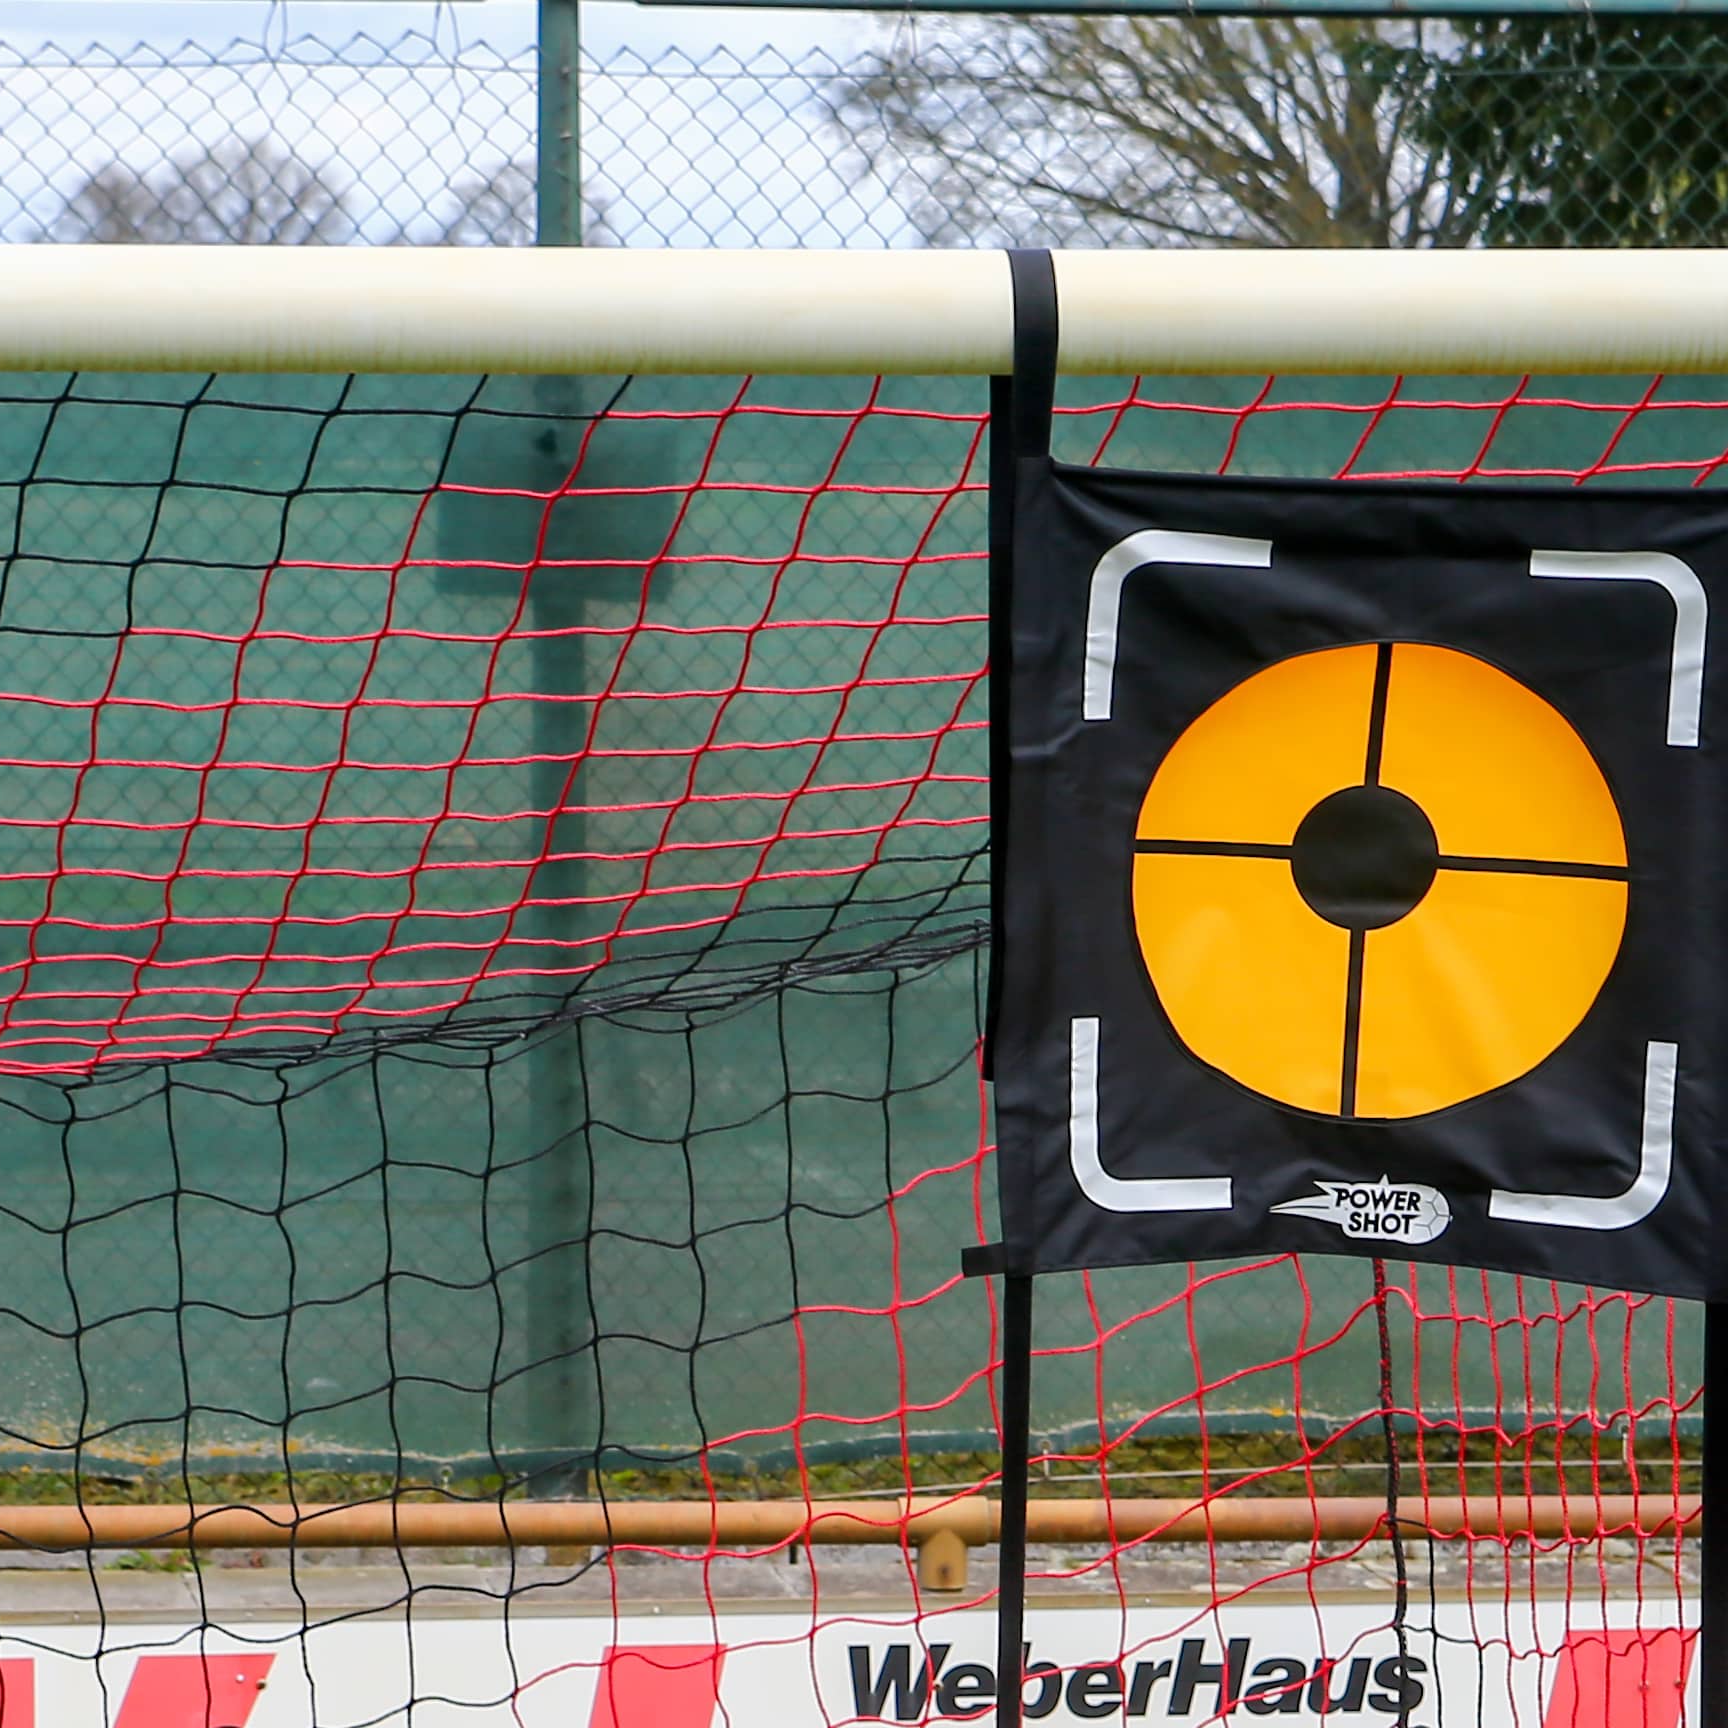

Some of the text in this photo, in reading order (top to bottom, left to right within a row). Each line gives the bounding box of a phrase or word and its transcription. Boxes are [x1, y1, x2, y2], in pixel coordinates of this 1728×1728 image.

[1332, 1187, 1422, 1212] POWER
[1348, 1211, 1421, 1235] SHOT
[847, 1638, 1428, 1720] WeberHaus
